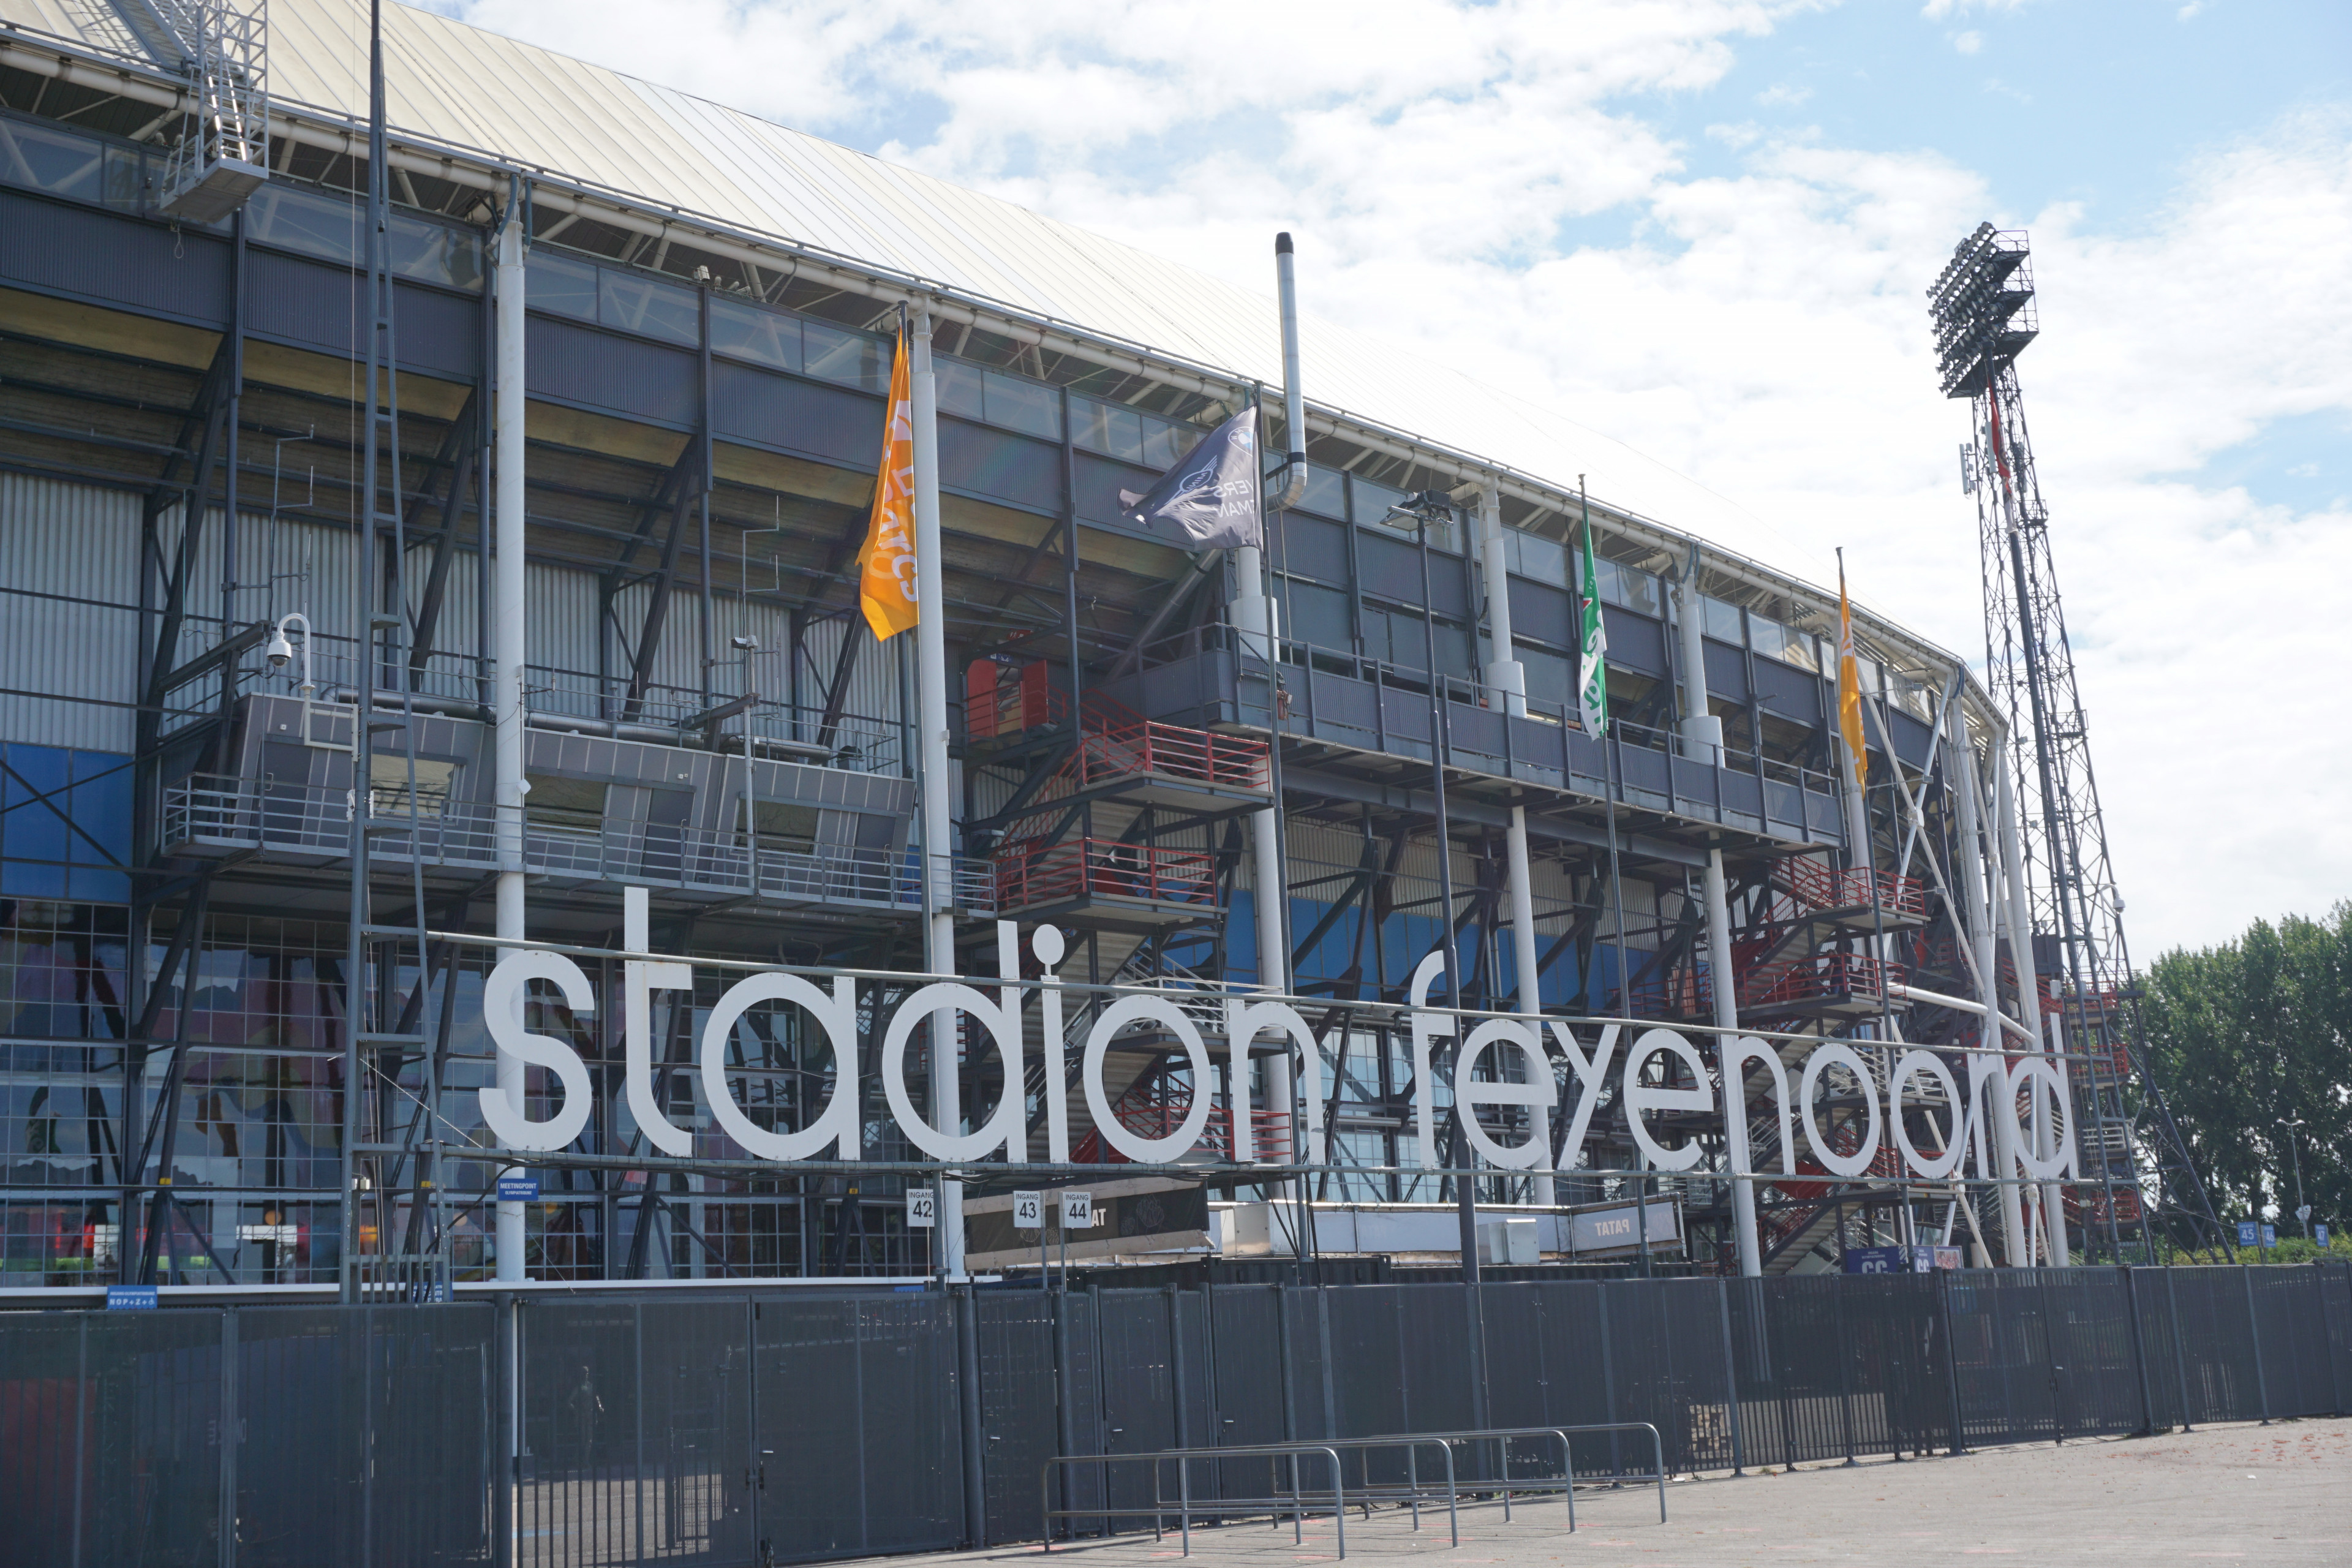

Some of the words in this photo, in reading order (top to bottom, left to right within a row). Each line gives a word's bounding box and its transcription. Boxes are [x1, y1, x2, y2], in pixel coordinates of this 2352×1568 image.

[479, 886, 1325, 1164] stadion
[1411, 949, 2078, 1180] feyenoord
[913, 1200, 932, 1218] 42
[1019, 1202, 1036, 1218] 43
[1069, 1203, 1087, 1219] 44
[2242, 1229, 2254, 1240] 45
[2266, 1231, 2274, 1242] 46
